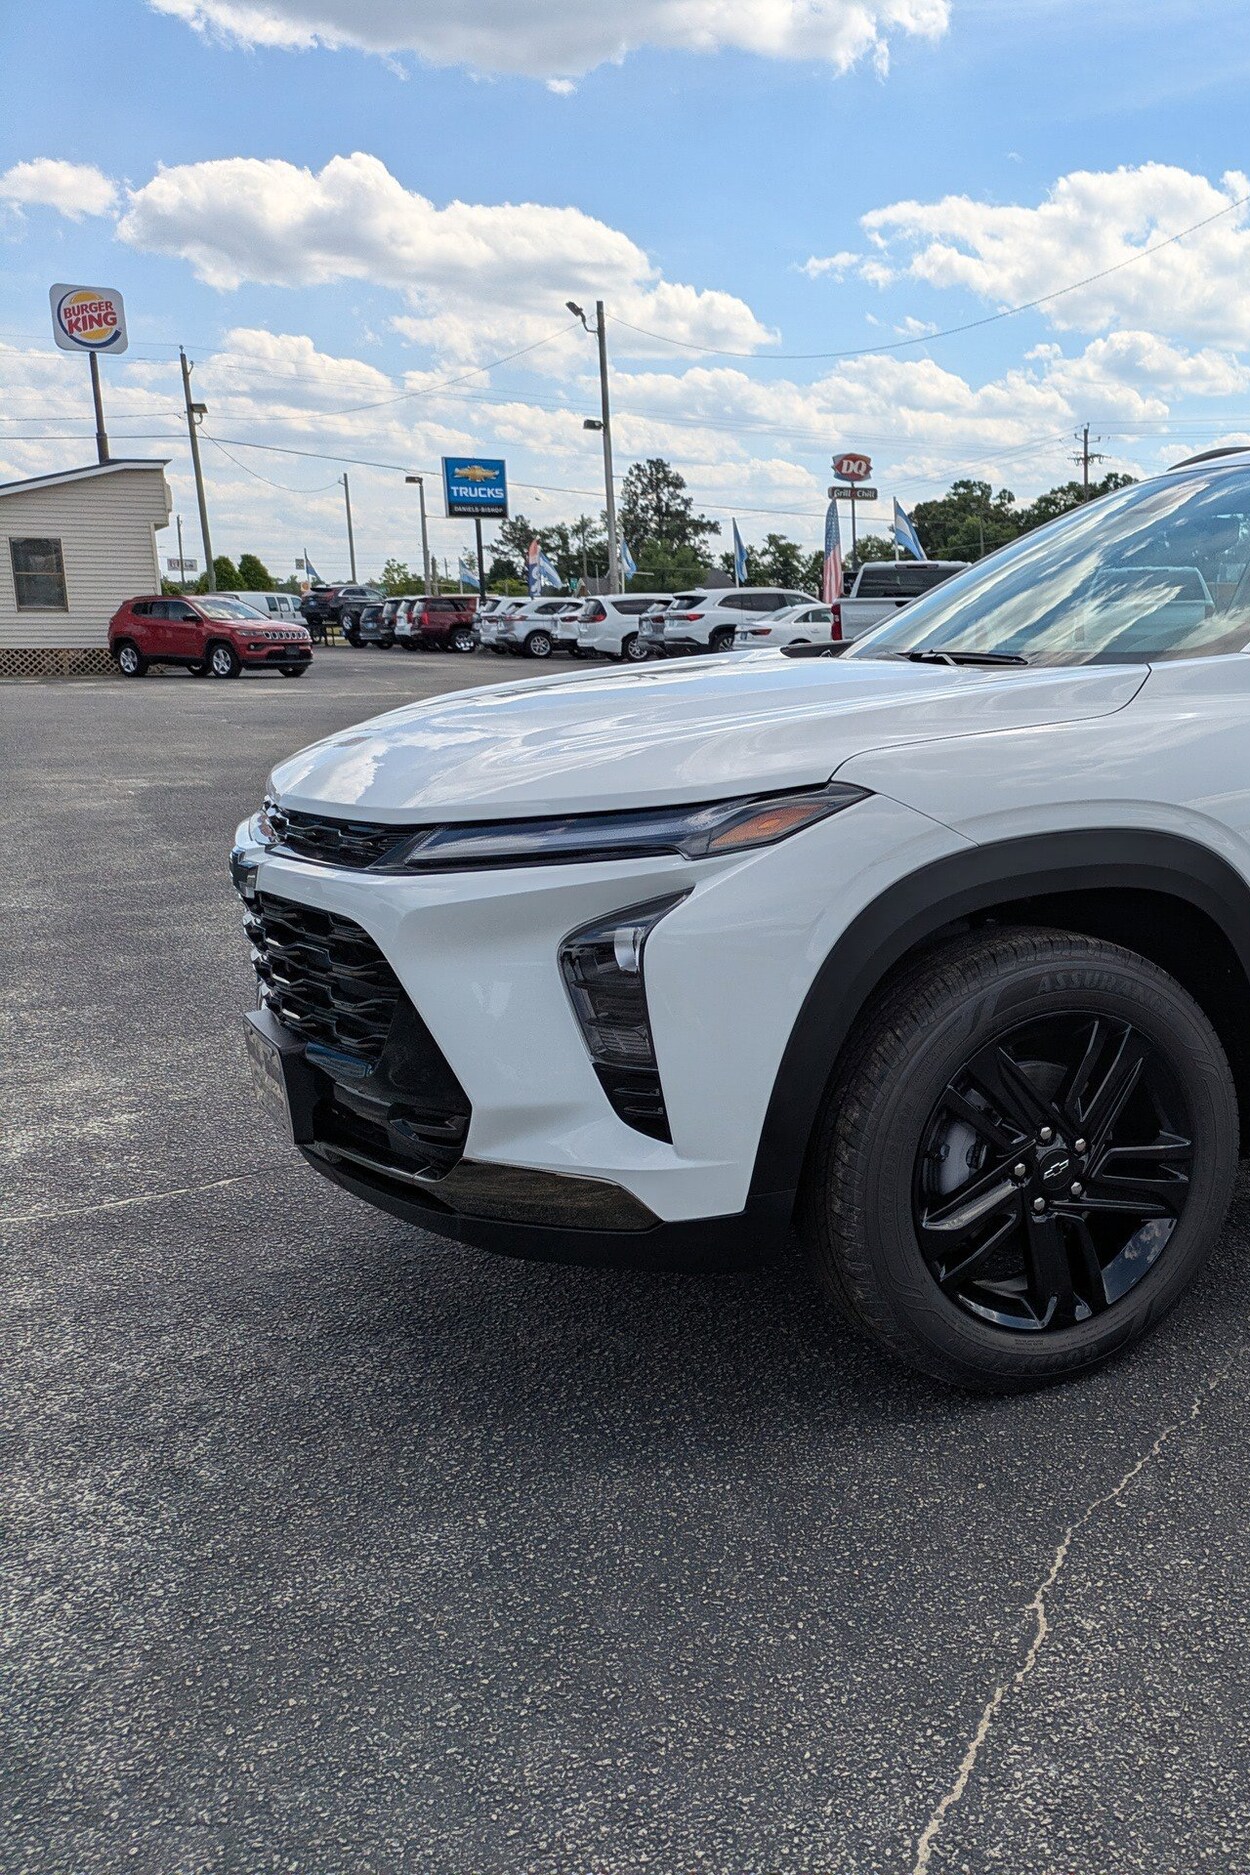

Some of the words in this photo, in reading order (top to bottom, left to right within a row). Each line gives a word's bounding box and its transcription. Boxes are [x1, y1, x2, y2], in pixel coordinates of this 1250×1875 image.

[64, 301, 113, 319] BURGER
[68, 312, 117, 334] KING
[842, 460, 867, 475] DQ
[451, 486, 504, 498] TRUCKS
